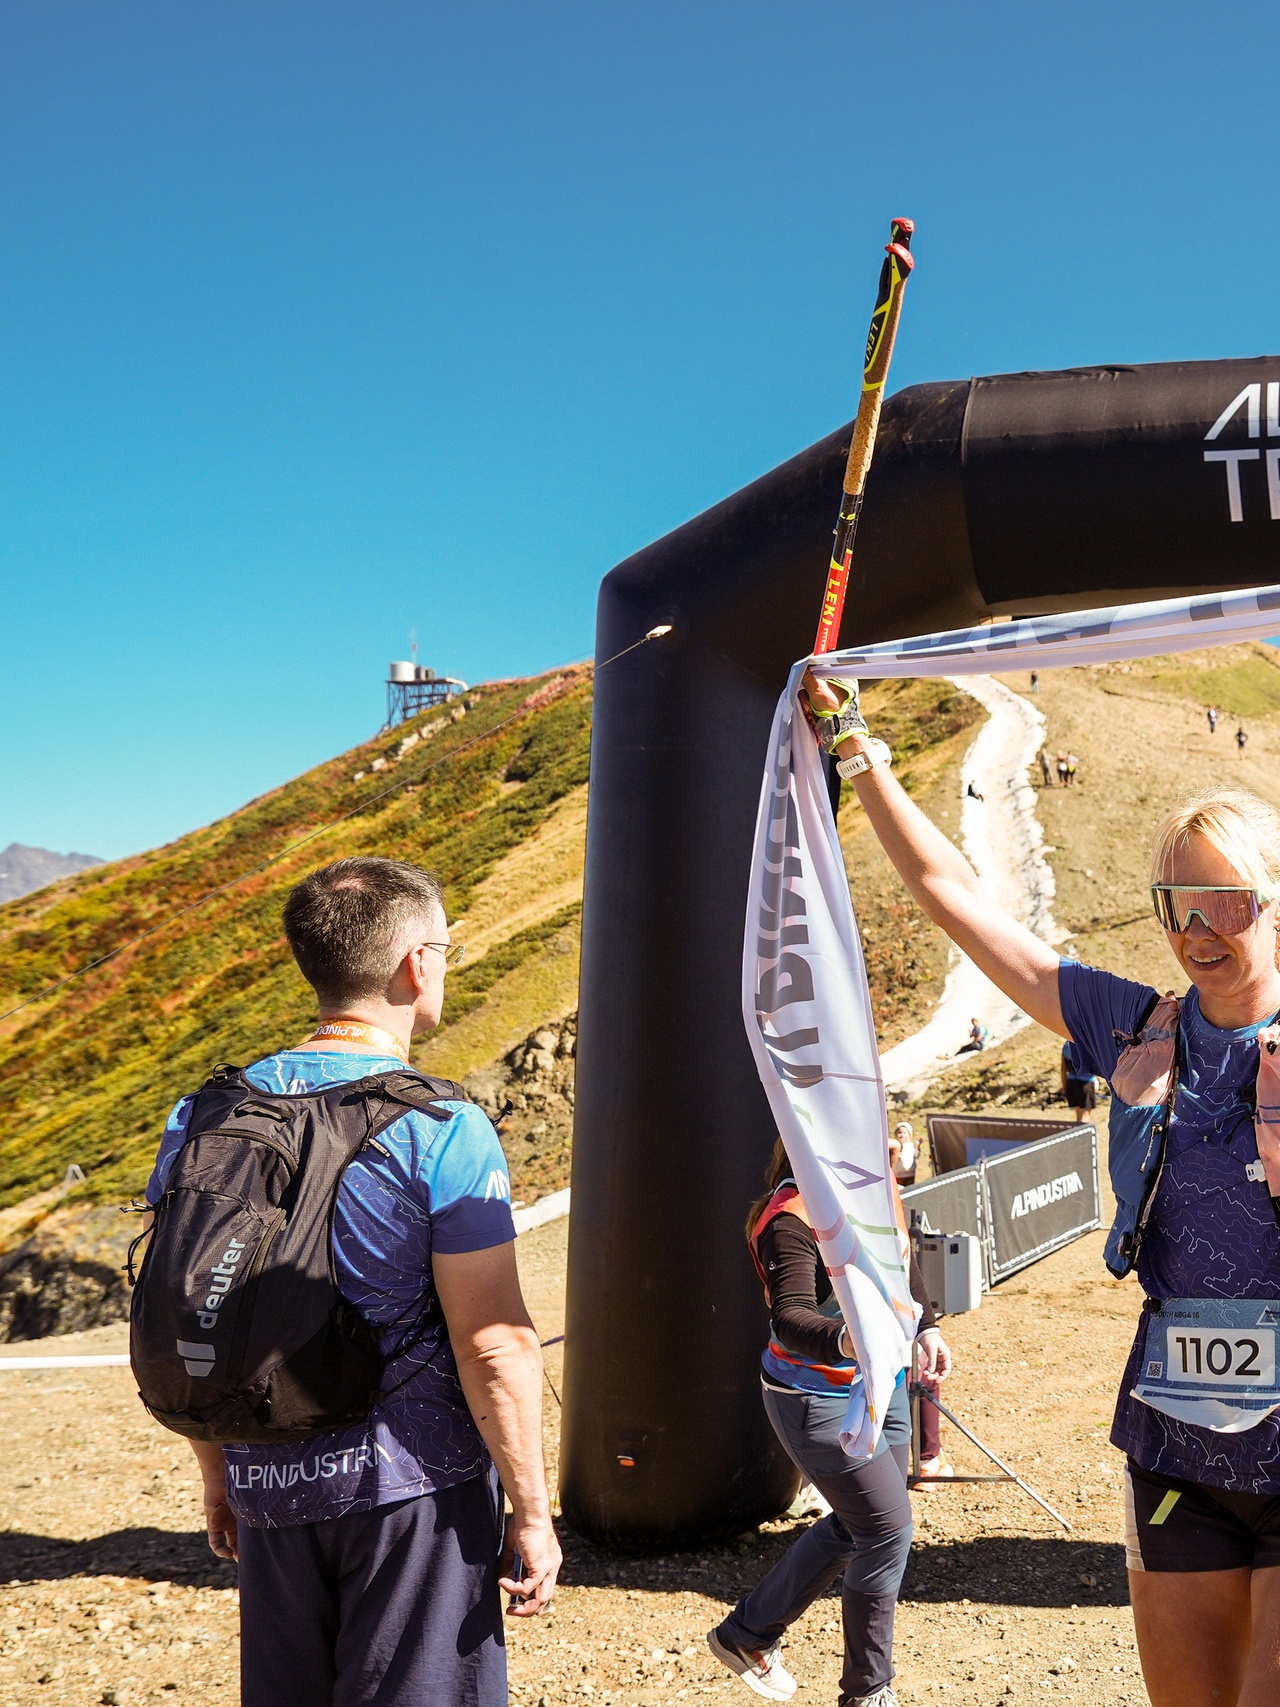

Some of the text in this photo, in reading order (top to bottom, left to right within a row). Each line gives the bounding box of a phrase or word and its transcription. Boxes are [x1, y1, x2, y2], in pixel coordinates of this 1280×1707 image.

[865, 322, 879, 362] LEKI
[822, 579, 840, 626] LEKI
[1011, 1171, 1083, 1220] ALPINDUSTRIA
[196, 1237, 247, 1330] deuter
[1176, 1337, 1261, 1376] 1102
